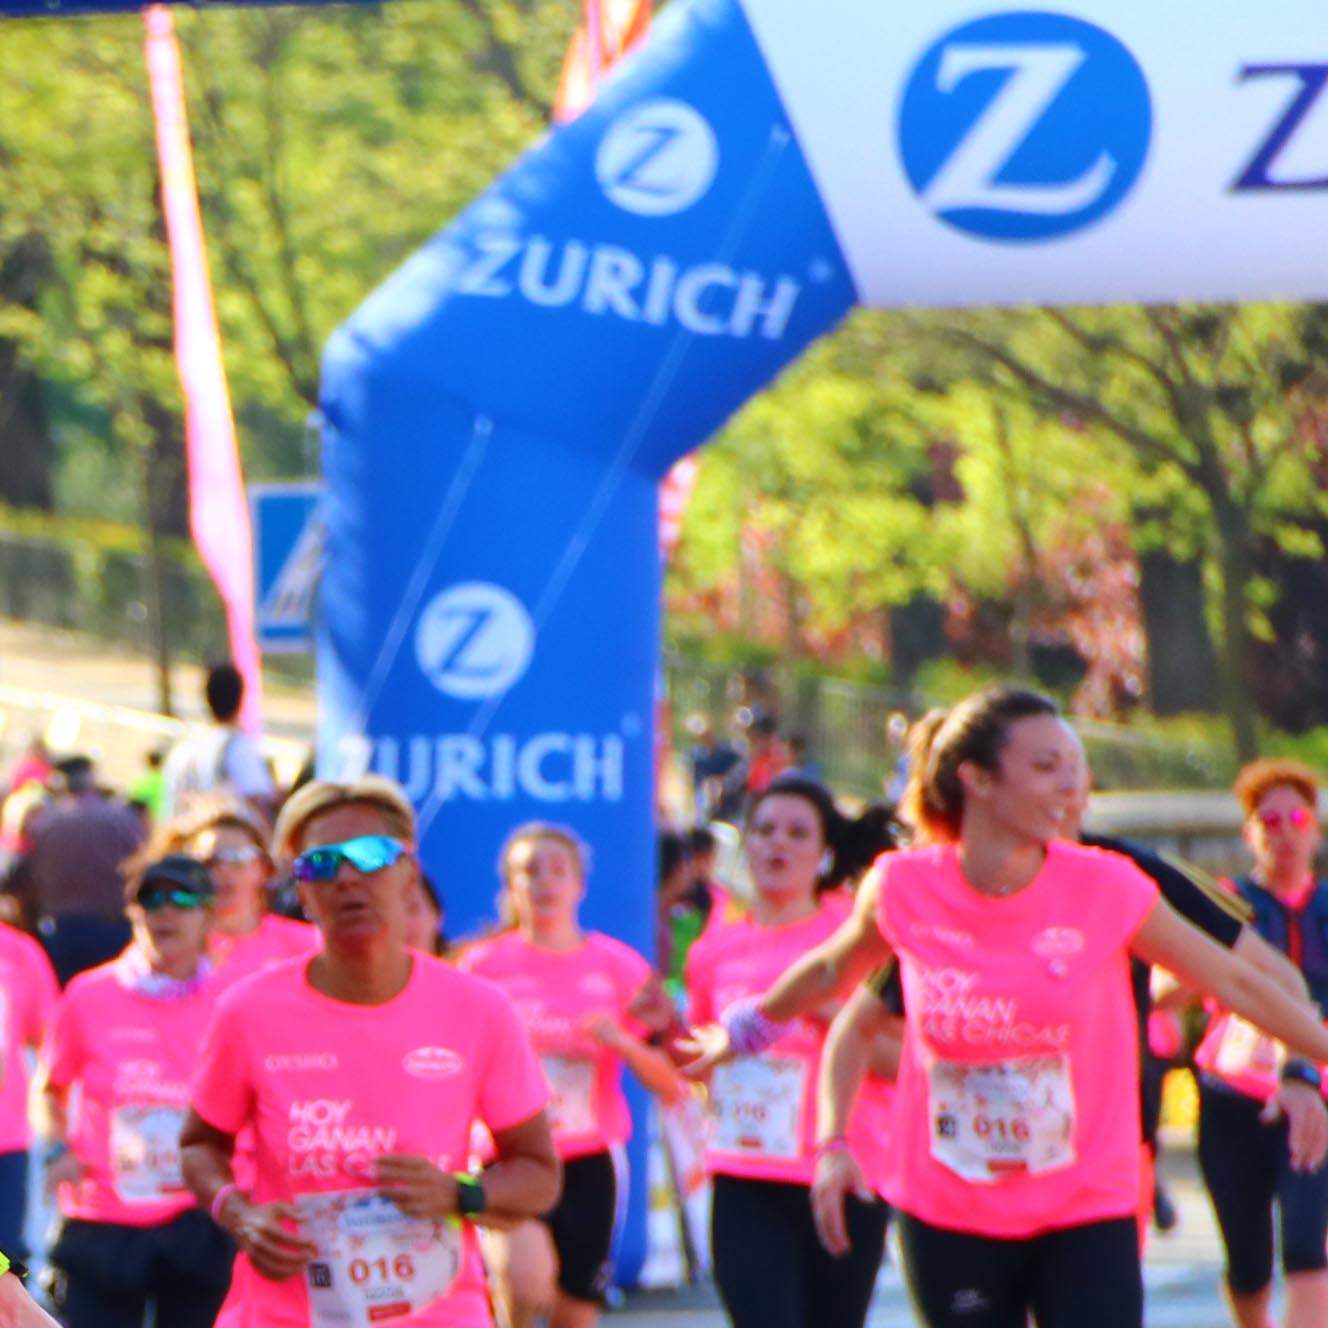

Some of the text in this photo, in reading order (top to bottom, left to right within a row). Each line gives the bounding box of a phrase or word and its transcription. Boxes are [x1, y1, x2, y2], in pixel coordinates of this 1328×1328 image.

[452, 233, 802, 340] ZURICH
[289, 1099, 352, 1126] HOY
[288, 1124, 397, 1151] GANAN
[348, 1253, 415, 1284] 016
